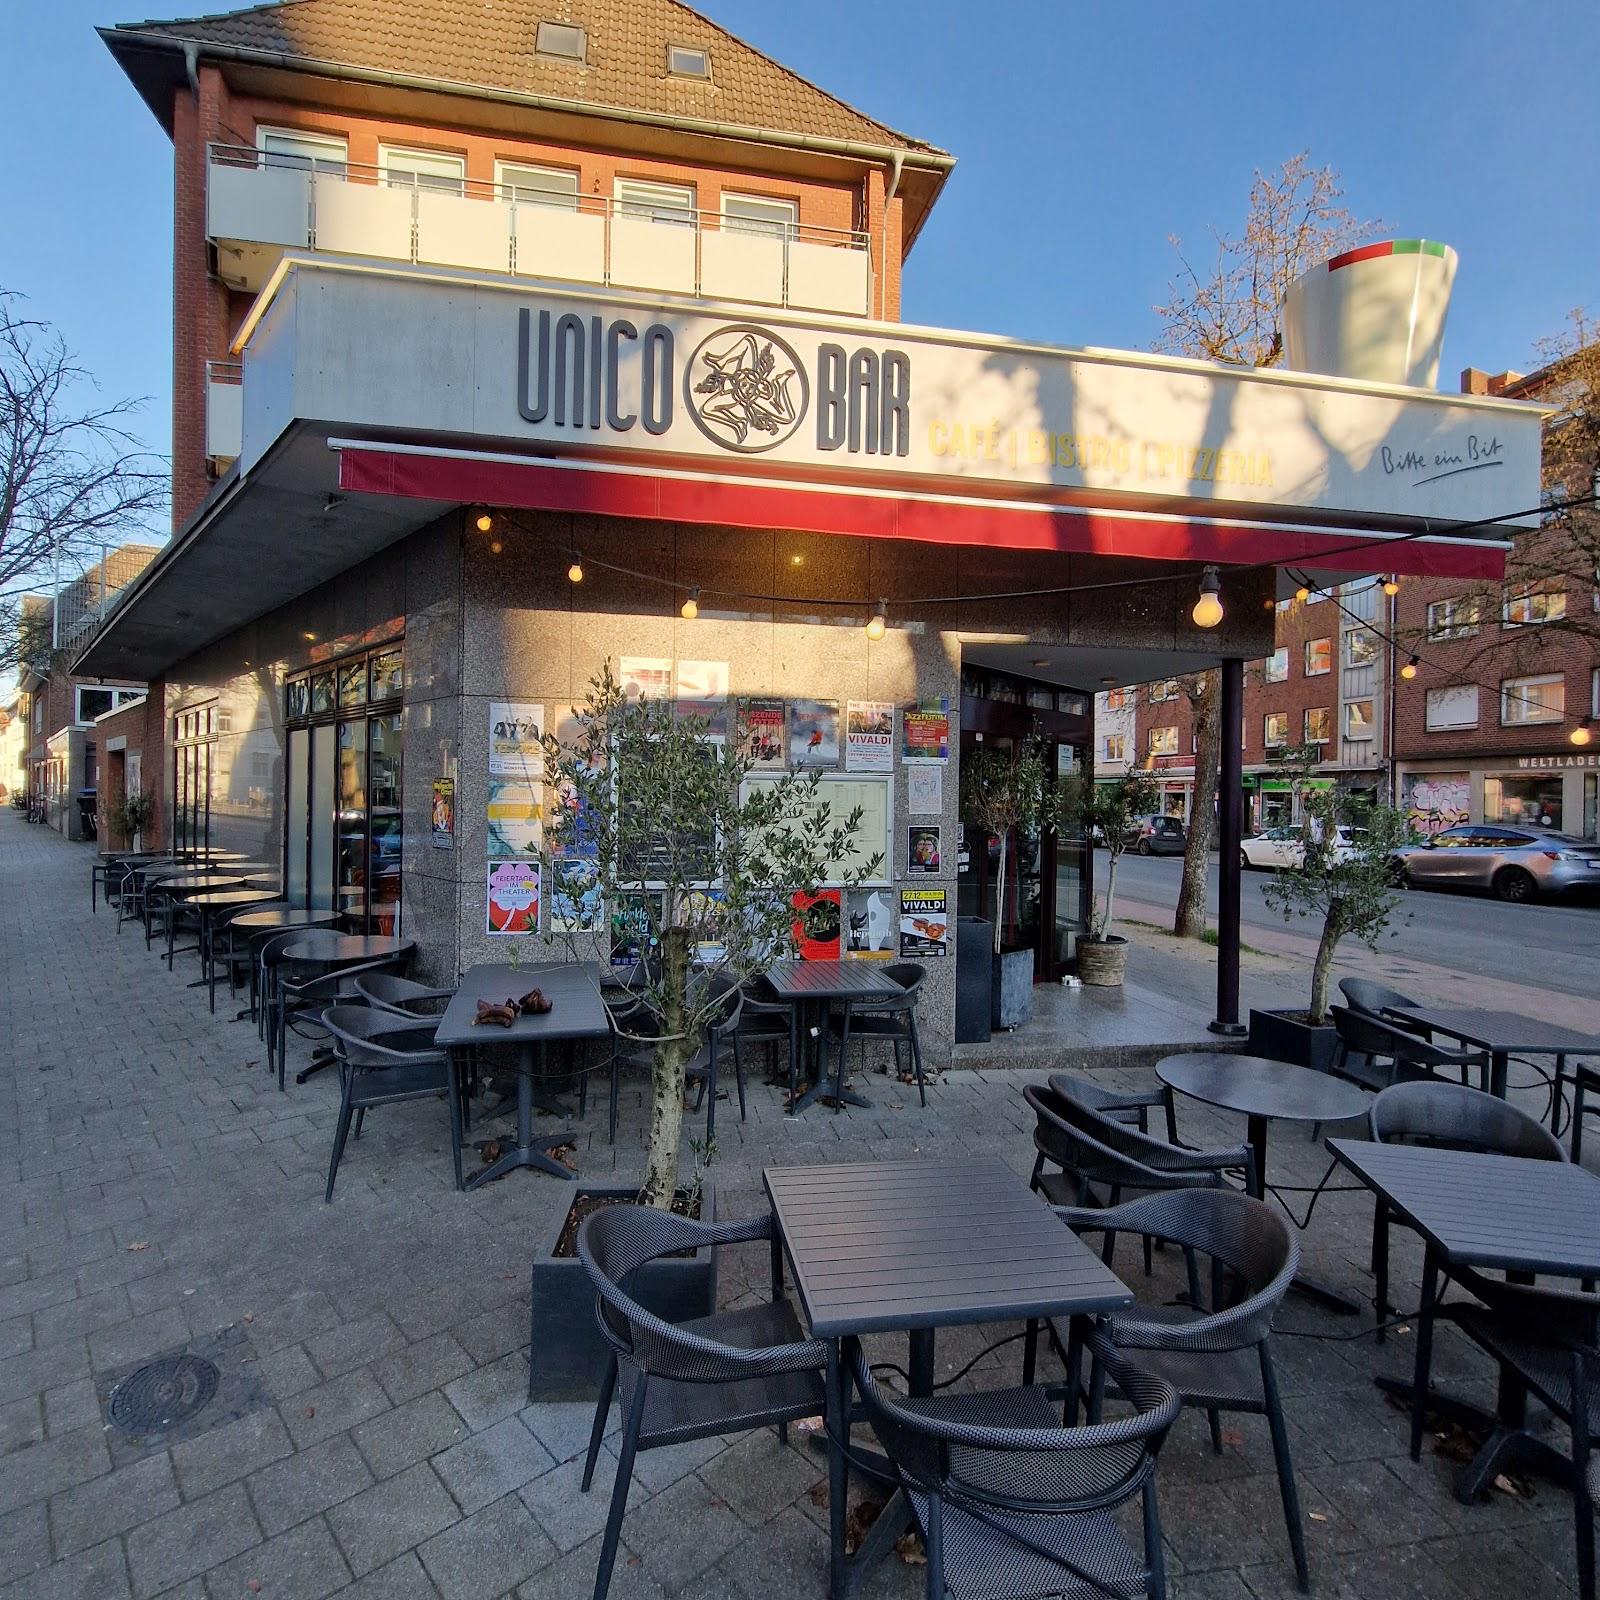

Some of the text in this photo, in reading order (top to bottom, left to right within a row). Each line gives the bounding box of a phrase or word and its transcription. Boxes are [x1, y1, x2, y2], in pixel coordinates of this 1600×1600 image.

[517, 307, 912, 457] UNICO BAR
[928, 416, 1000, 461] CAFÉ
[1028, 431, 1130, 474] BISTRO
[1157, 443, 1275, 487] PIZZERIA
[1381, 435, 1503, 474] Bitte ein Bit
[848, 735, 891, 745] VIVALDI
[902, 900, 945, 910] VIVALDI
